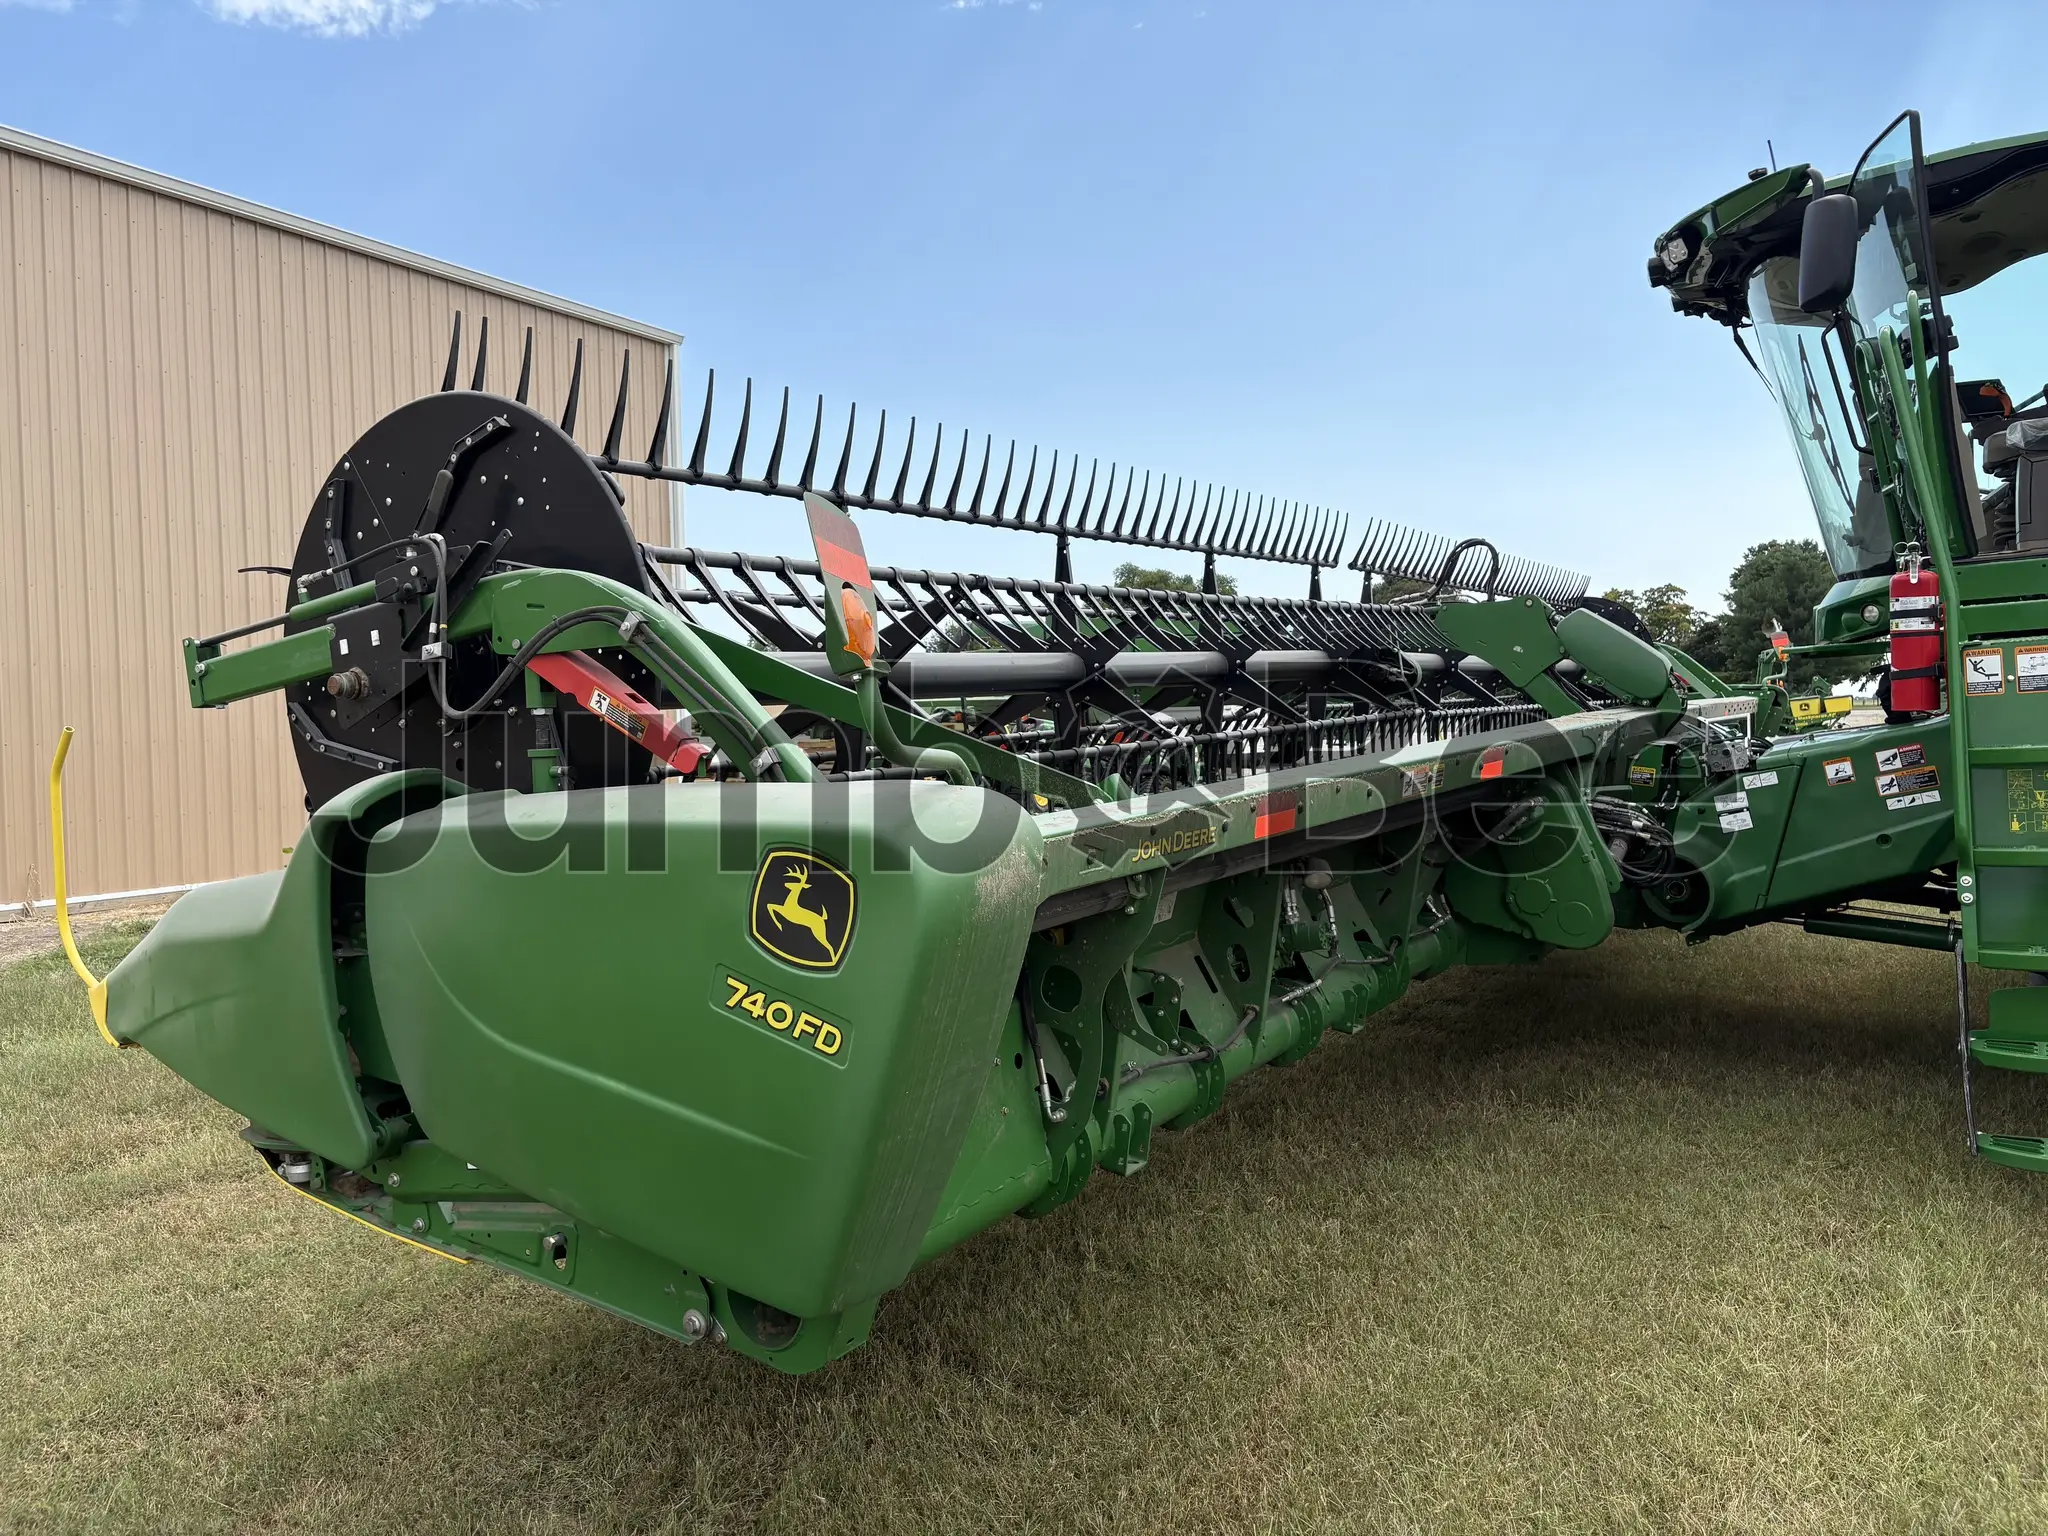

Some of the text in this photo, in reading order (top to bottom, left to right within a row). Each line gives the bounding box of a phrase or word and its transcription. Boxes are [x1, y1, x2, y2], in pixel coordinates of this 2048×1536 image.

[1131, 826, 1217, 862] JOHN DEERE
[725, 975, 843, 1056] 740FD
